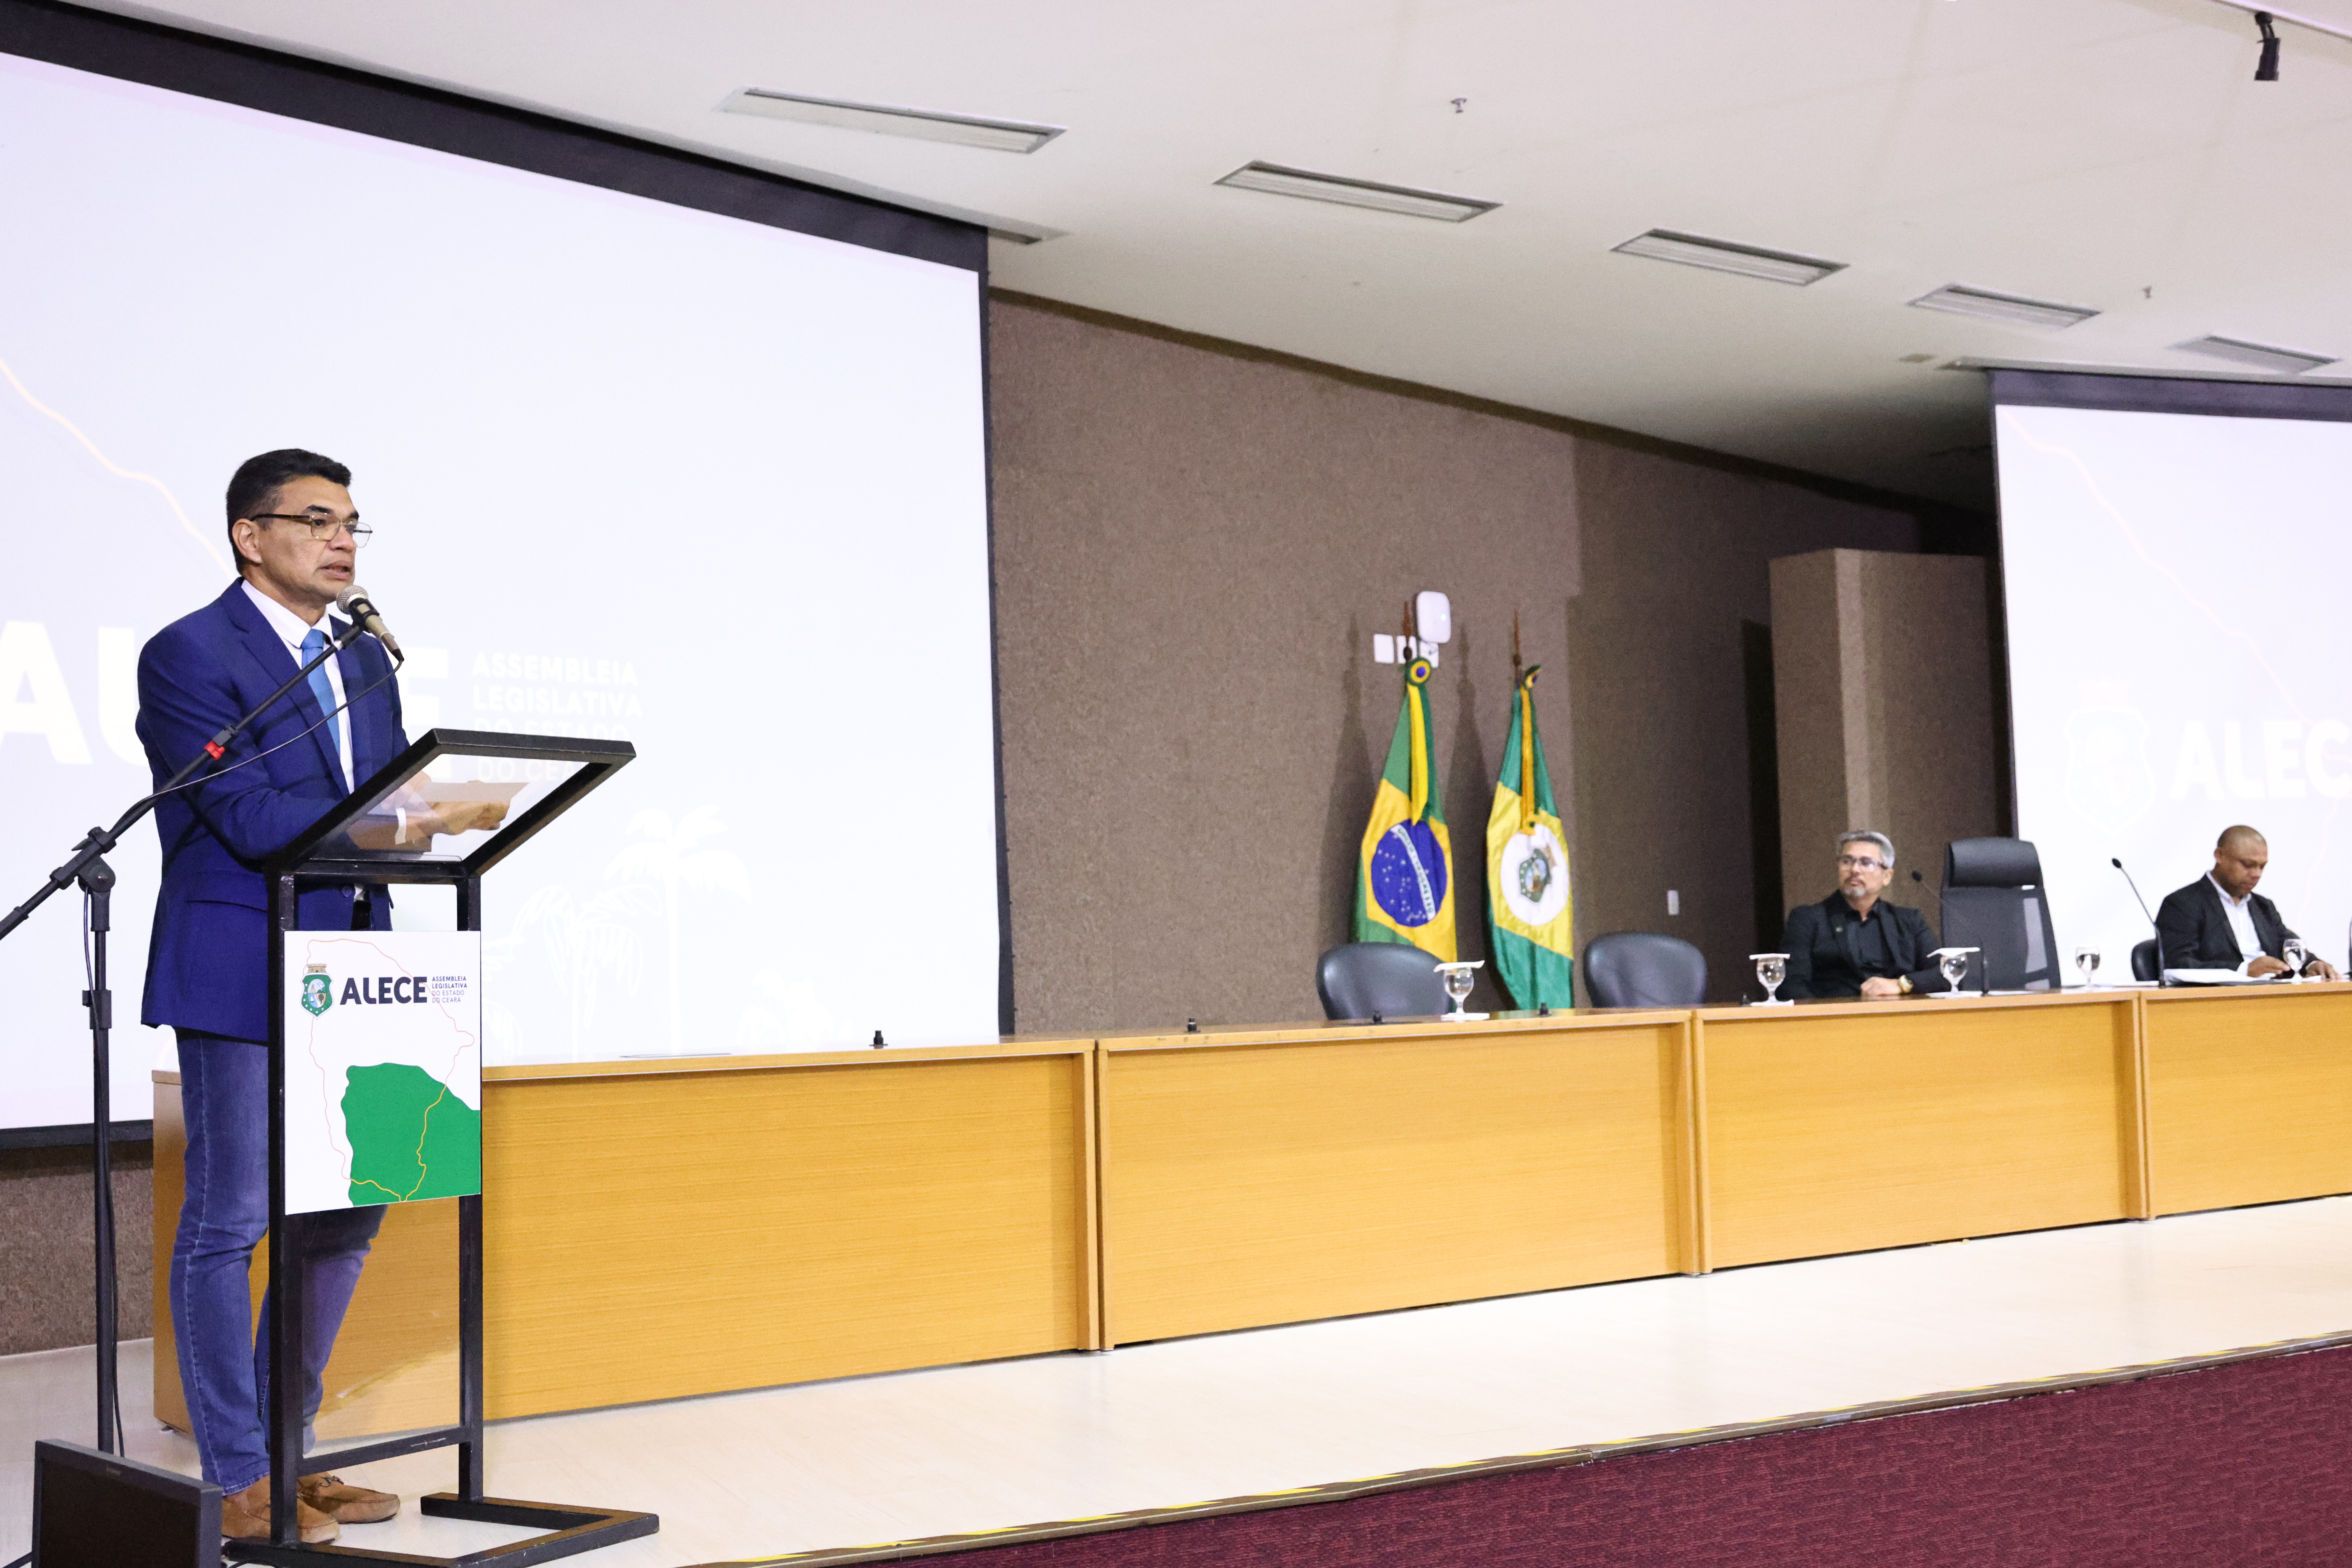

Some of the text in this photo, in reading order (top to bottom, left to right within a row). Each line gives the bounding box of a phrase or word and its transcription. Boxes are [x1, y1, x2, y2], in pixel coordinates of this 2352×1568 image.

[472, 651, 639, 686] ASSEMBLEIA
[472, 685, 643, 718] LEGISLATIVA
[477, 756, 587, 781] DO CEA
[339, 976, 427, 1005] ALECE
